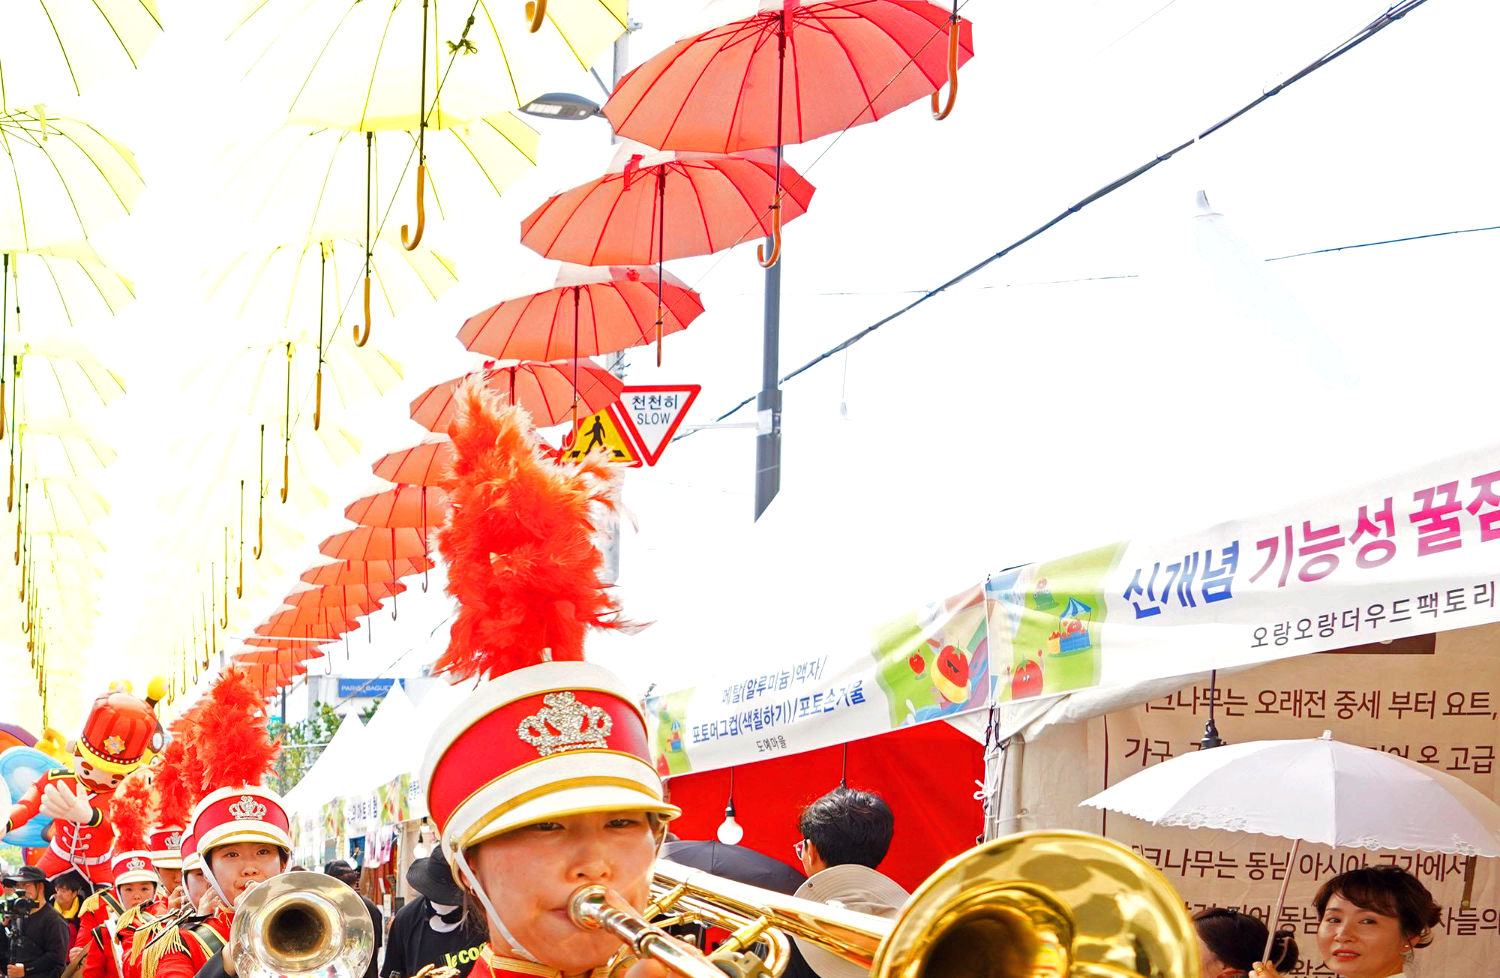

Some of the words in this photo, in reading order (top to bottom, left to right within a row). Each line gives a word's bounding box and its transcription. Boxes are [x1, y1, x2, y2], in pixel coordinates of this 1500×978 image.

[632, 394, 678, 411] 천천히
[636, 412, 671, 425] SLOW
[1122, 540, 1240, 620] 신개념
[1248, 496, 1398, 588] 기능성
[1251, 580, 1495, 649] 오랑오랑더우드팩토리
[721, 655, 828, 706] 메탈(알루미늄)액자/
[1145, 686, 1249, 717] 크나무는
[1254, 688, 1326, 719] 오래전
[1334, 690, 1381, 720] 중세
[1388, 690, 1437, 720] 부터
[1442, 691, 1498, 721] 요트,
[1446, 745, 1496, 774] 고급
